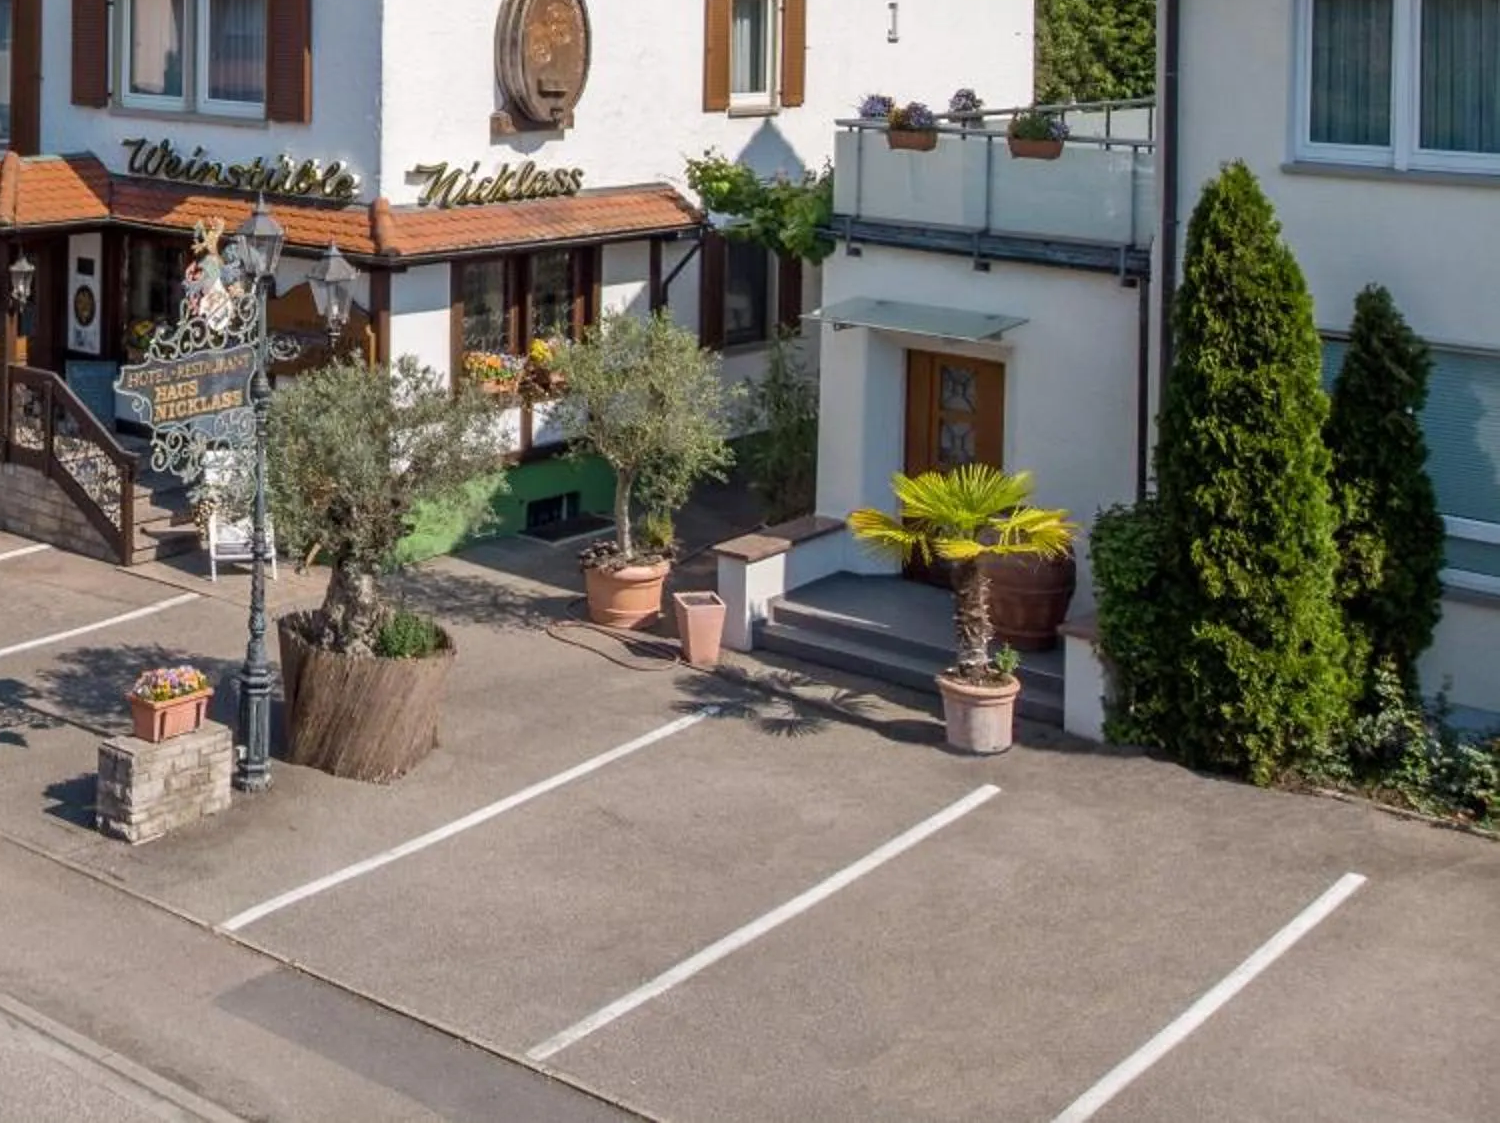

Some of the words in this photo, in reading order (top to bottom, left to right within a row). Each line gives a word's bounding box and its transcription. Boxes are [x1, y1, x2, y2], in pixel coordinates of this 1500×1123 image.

[121, 137, 362, 200] Weinstüble
[414, 160, 585, 209] Nicklass
[127, 368, 170, 388] HOTEL
[177, 354, 250, 378] RESTAURANT
[153, 389, 243, 423] NICKLASS
[154, 380, 198, 403] HAUS
